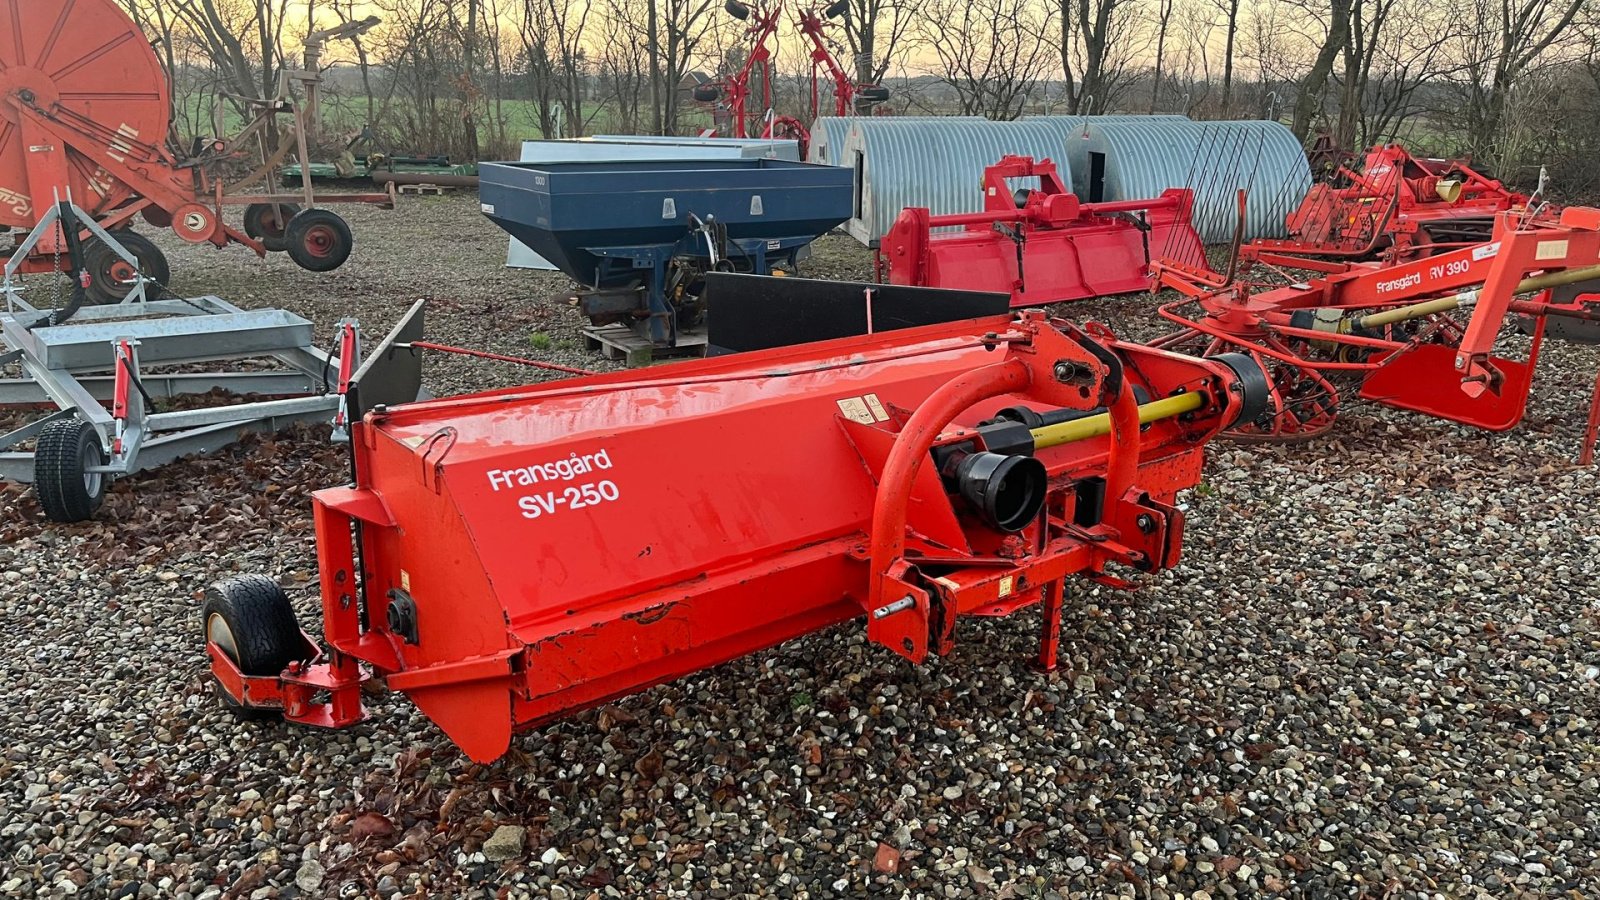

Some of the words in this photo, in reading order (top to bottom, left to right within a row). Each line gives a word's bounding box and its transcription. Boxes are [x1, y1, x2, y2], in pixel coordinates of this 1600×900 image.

[1377, 272, 1420, 294] Fransgård
[1430, 265, 1444, 280] RV
[1447, 259, 1469, 276] 390
[487, 449, 612, 491] Fransgård
[518, 480, 619, 518] SV-250
